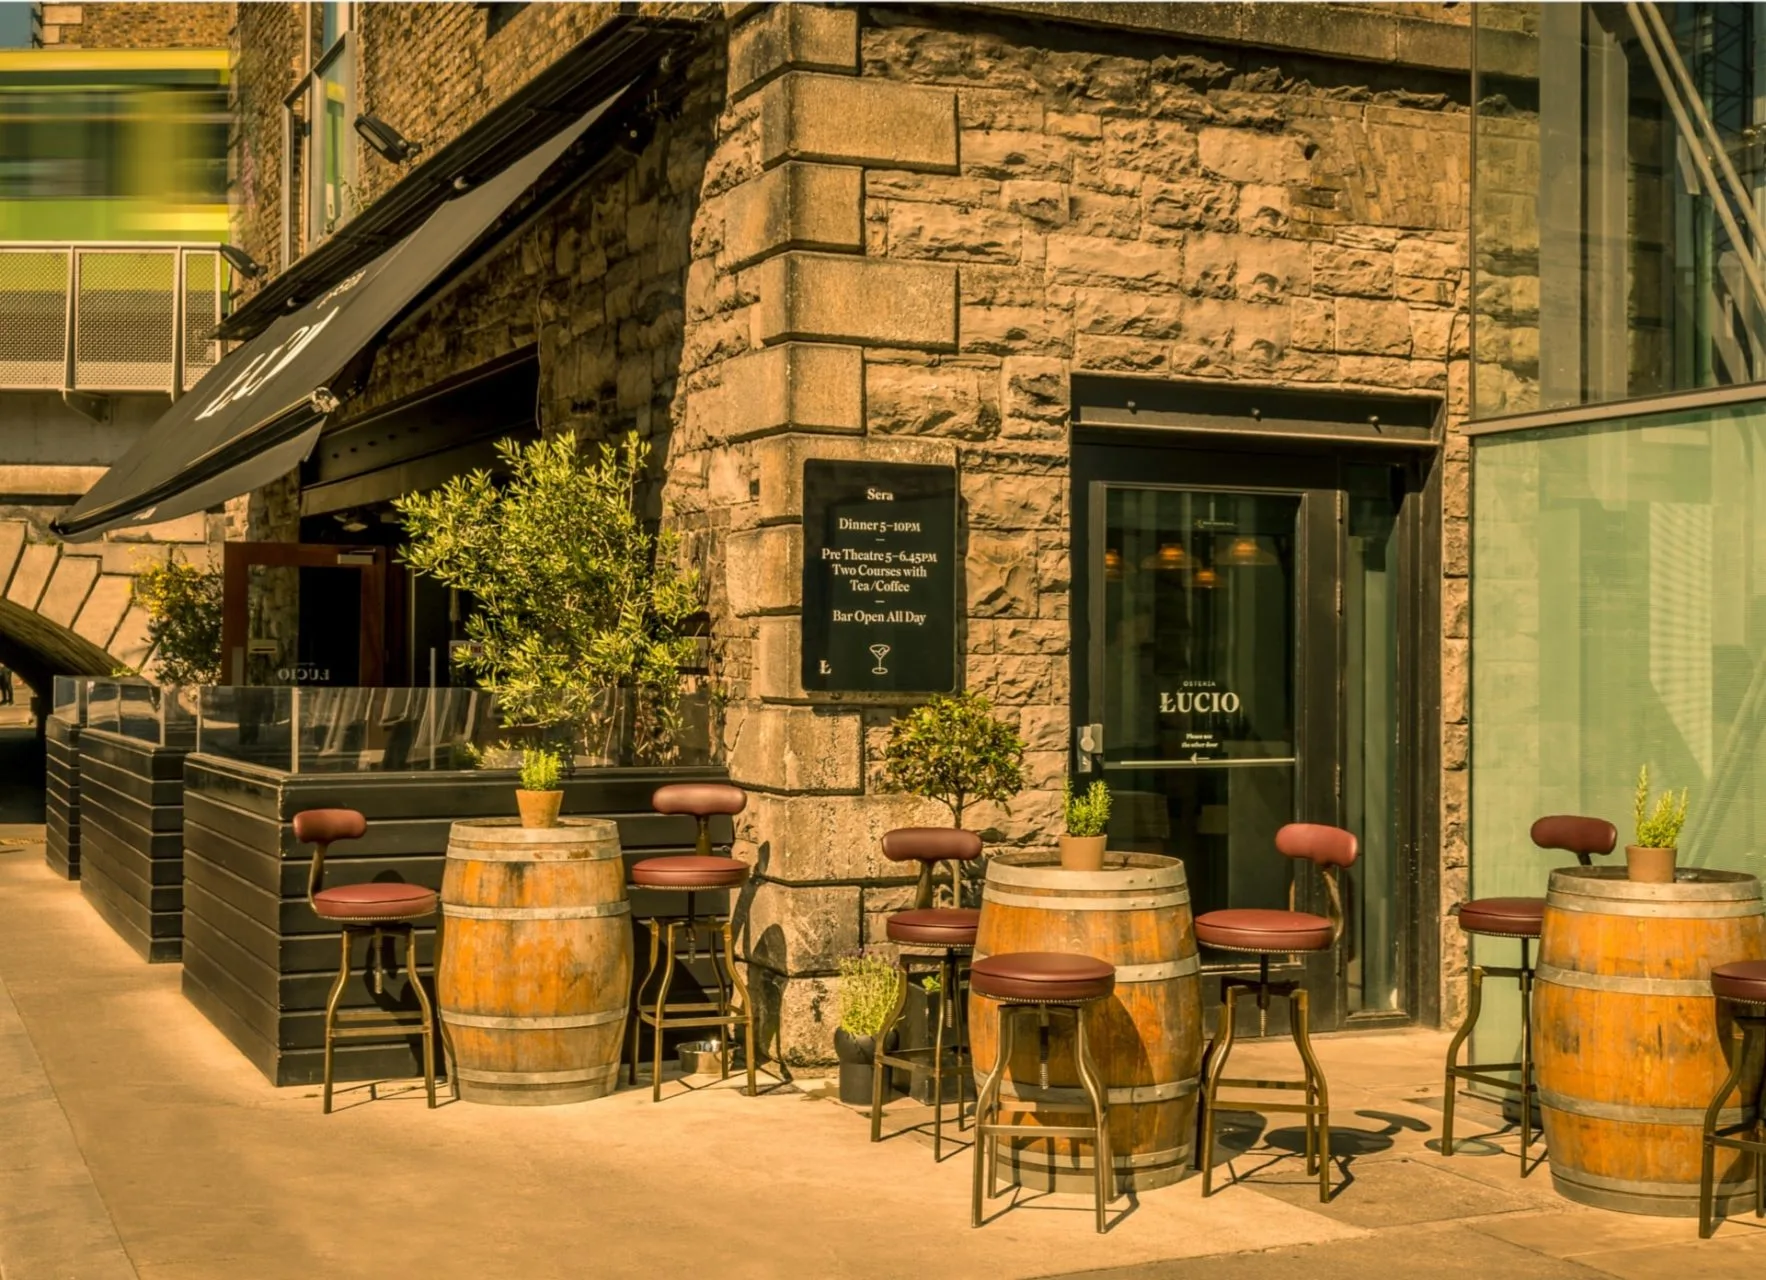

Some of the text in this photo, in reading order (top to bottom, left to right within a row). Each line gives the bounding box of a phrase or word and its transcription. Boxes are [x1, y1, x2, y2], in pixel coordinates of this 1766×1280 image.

[867, 488, 893, 500] Sera
[839, 518, 879, 530] Dinner
[822, 548, 841, 560] Pre
[842, 549, 884, 561] Theatre
[832, 564, 927, 577] Two Courses with
[833, 610, 926, 625] Bar Open All Day
